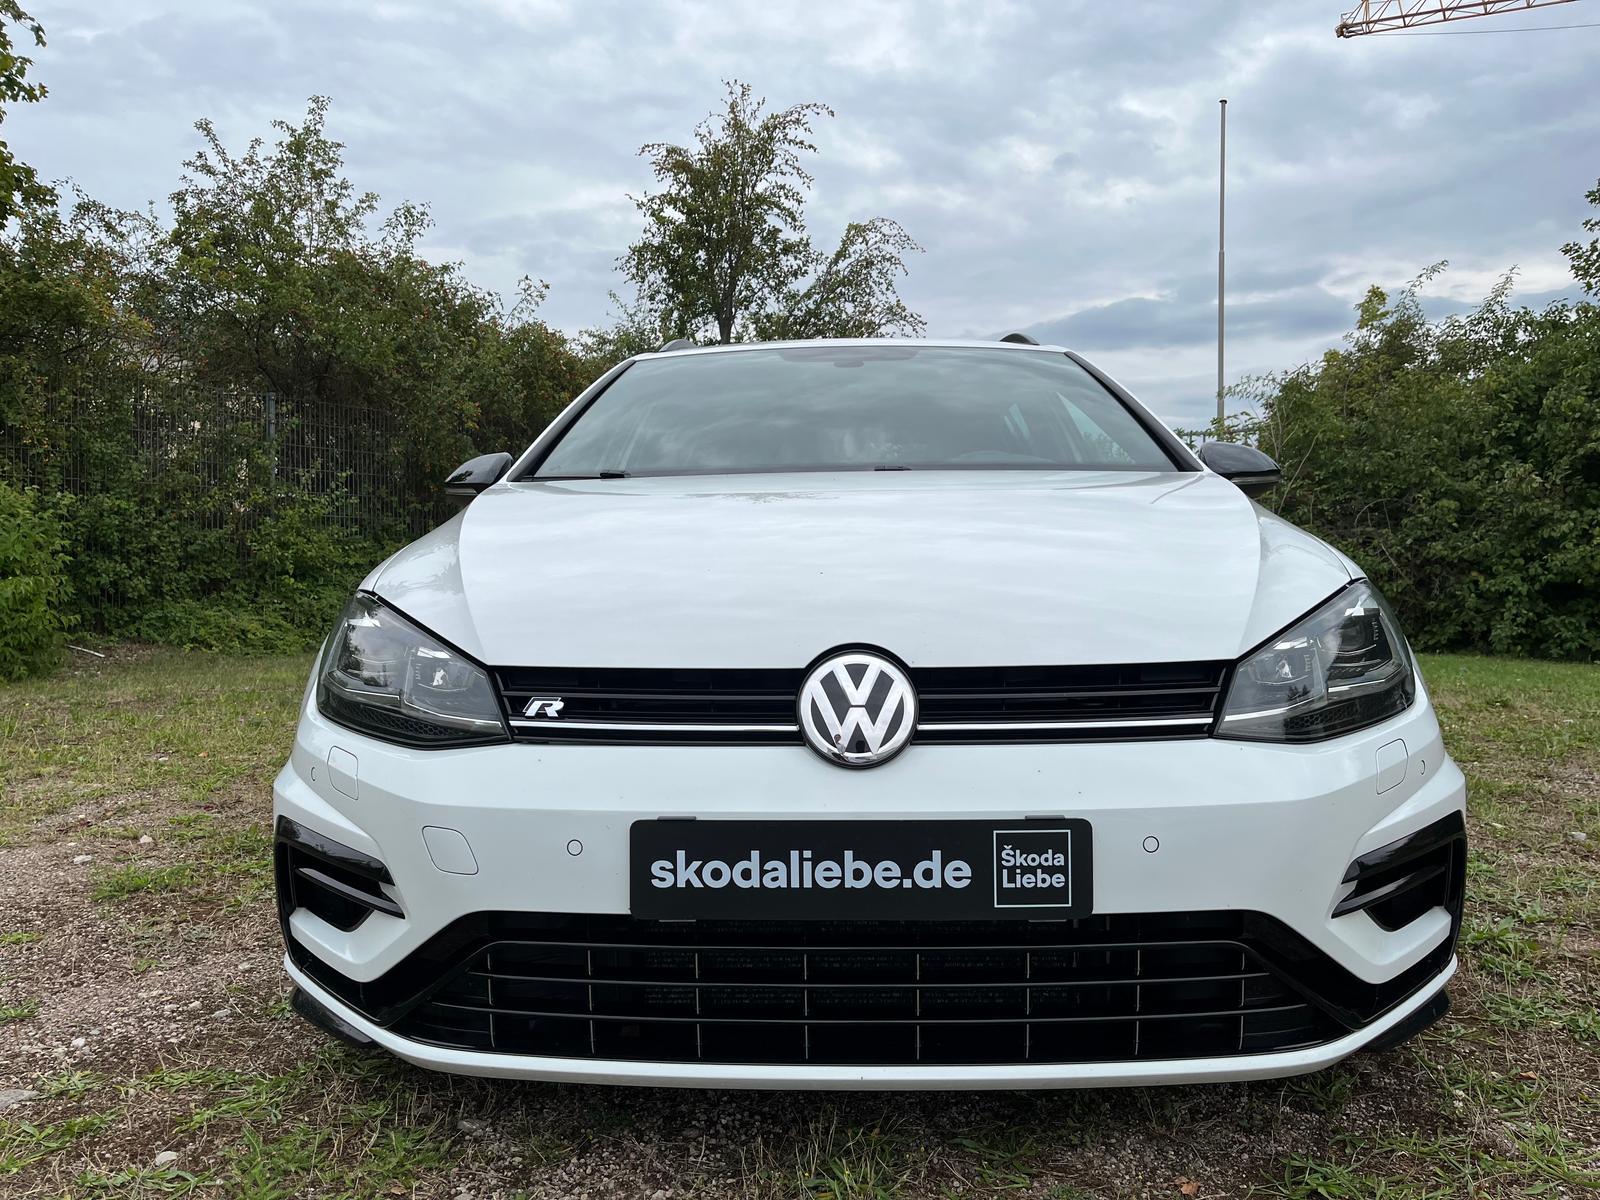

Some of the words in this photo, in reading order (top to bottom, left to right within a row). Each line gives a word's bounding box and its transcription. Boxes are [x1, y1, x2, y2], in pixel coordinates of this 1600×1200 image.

[522, 697, 564, 717] R
[804, 657, 911, 760] VW
[1002, 845, 1064, 866] Škoda
[651, 850, 971, 888] skodaliebe.de
[1003, 869, 1065, 887] Liebe
